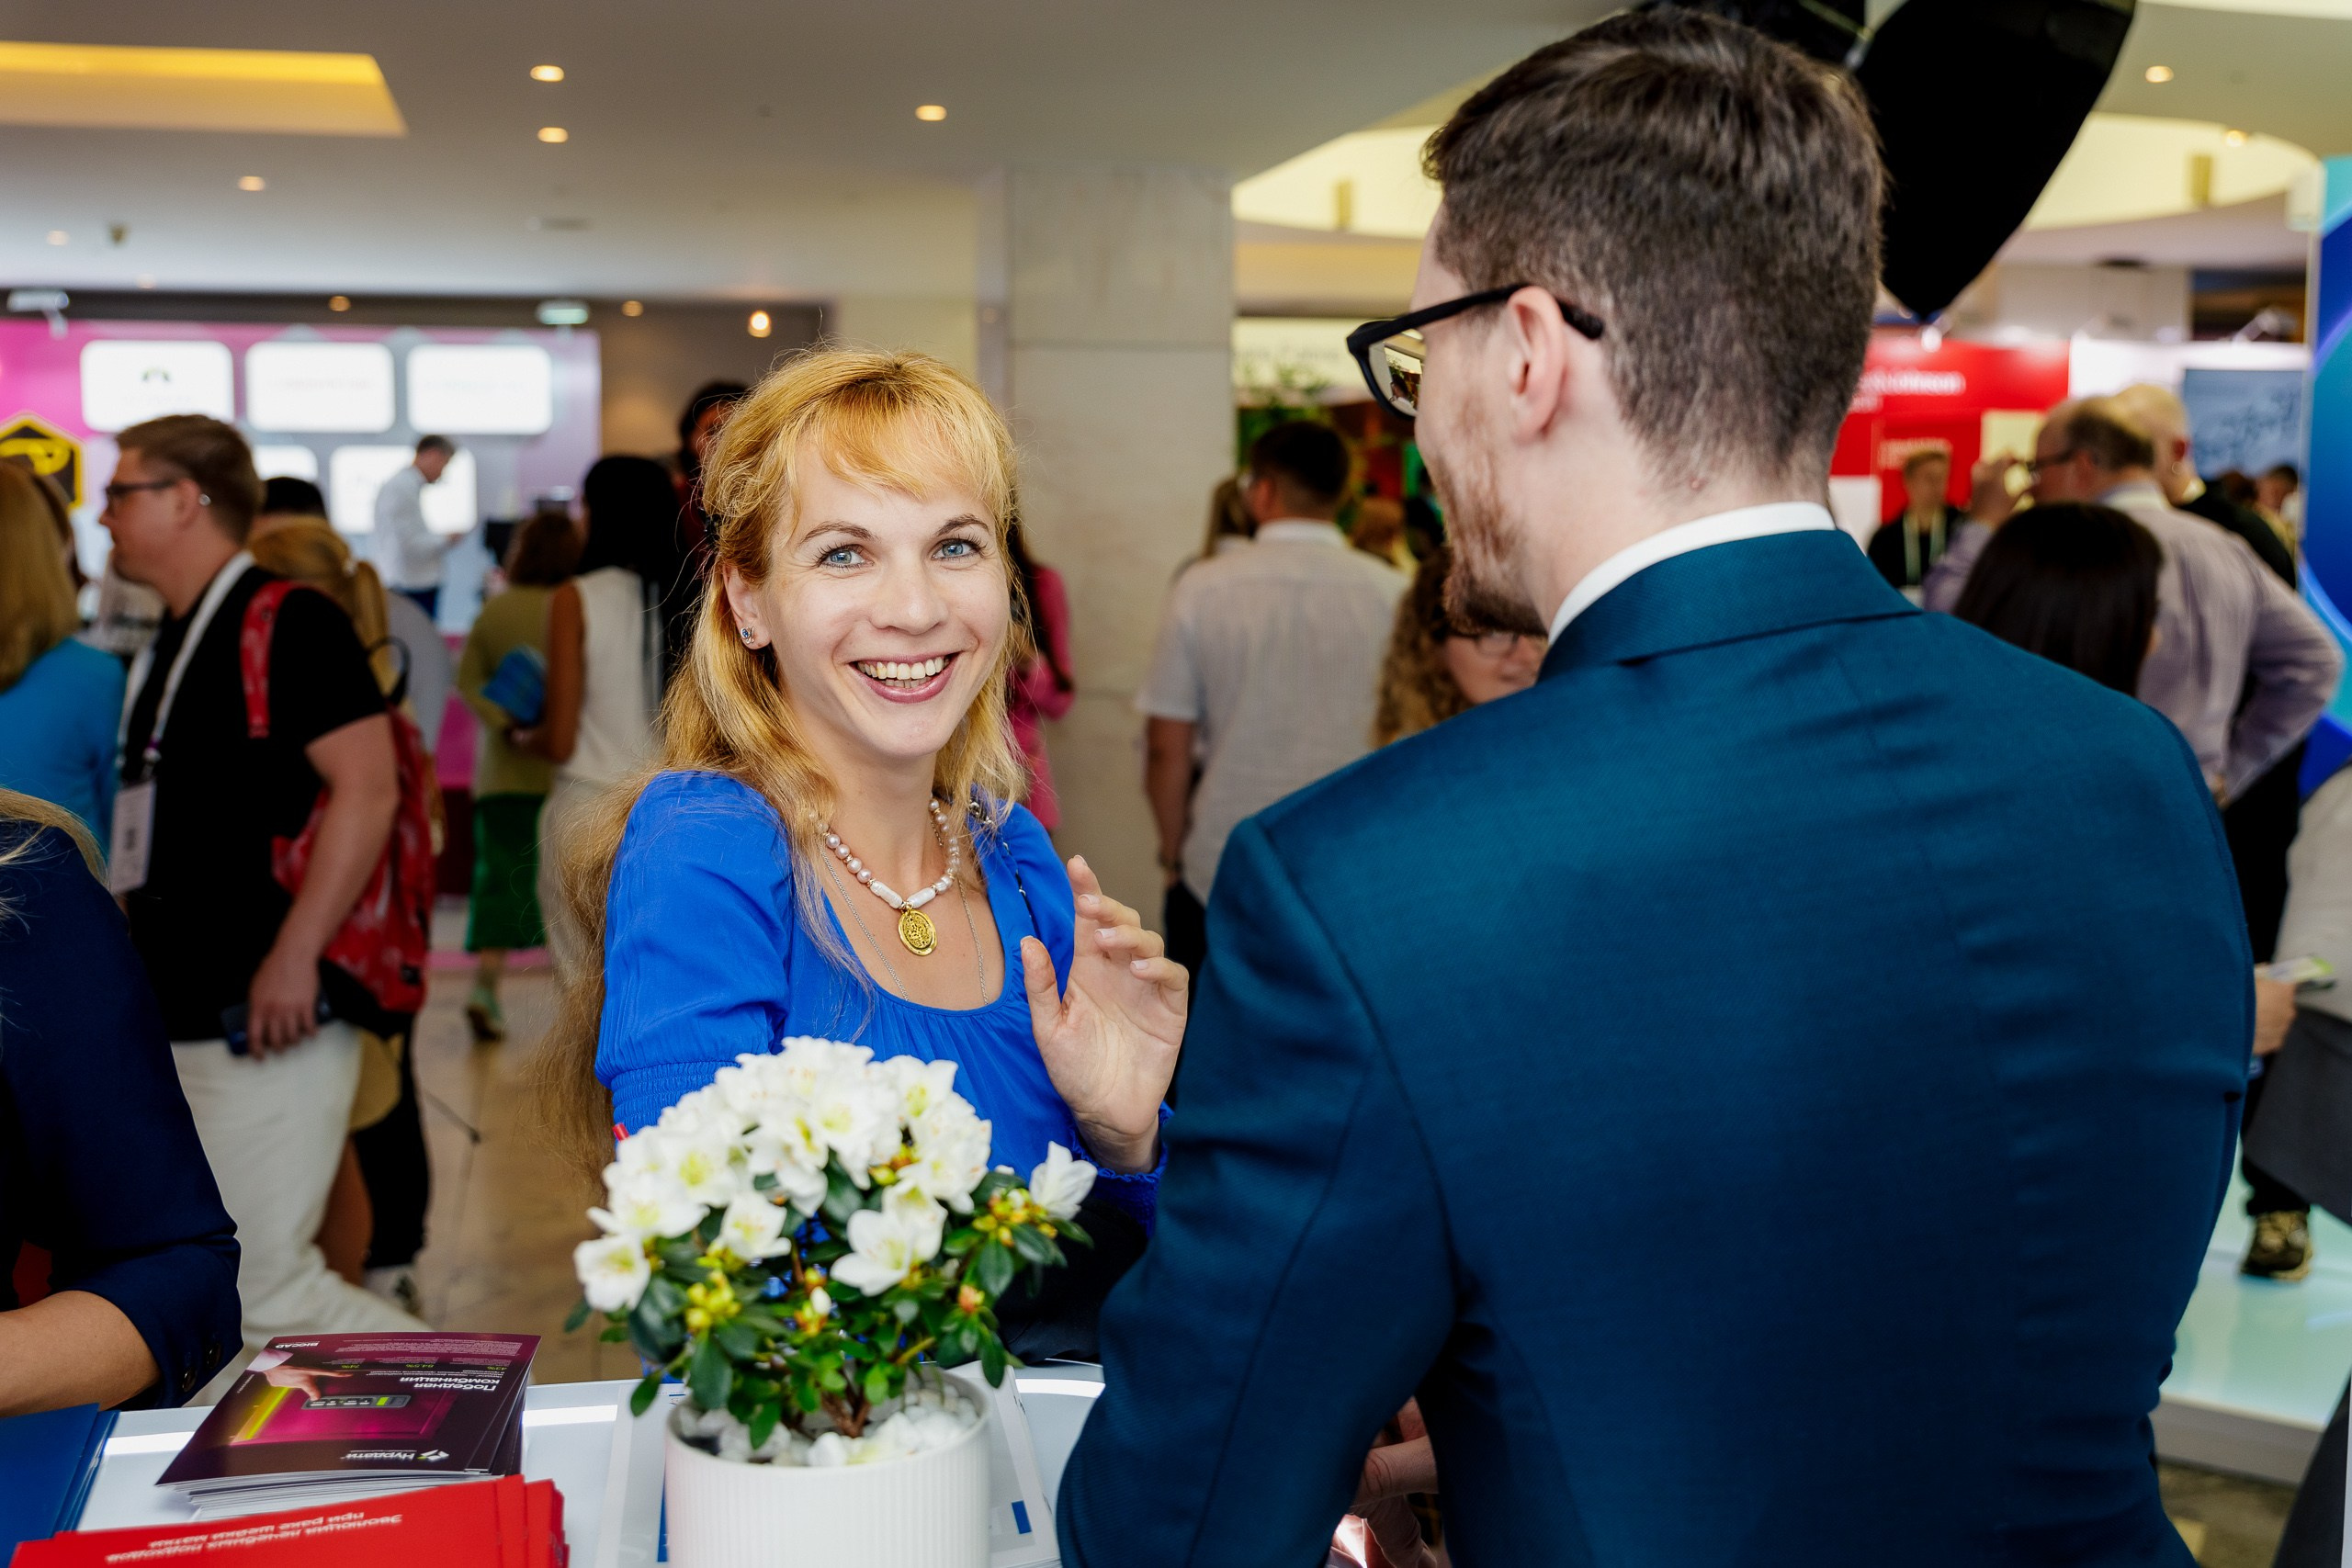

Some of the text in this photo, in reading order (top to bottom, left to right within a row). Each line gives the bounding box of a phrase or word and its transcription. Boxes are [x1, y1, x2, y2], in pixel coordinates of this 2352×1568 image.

[399, 1376, 501, 1384] комбинация
[413, 1382, 497, 1392] Победная
[105, 1514, 403, 1563] Эволюция лечебных подходов
[148, 1512, 365, 1549] при раке шейки матки
